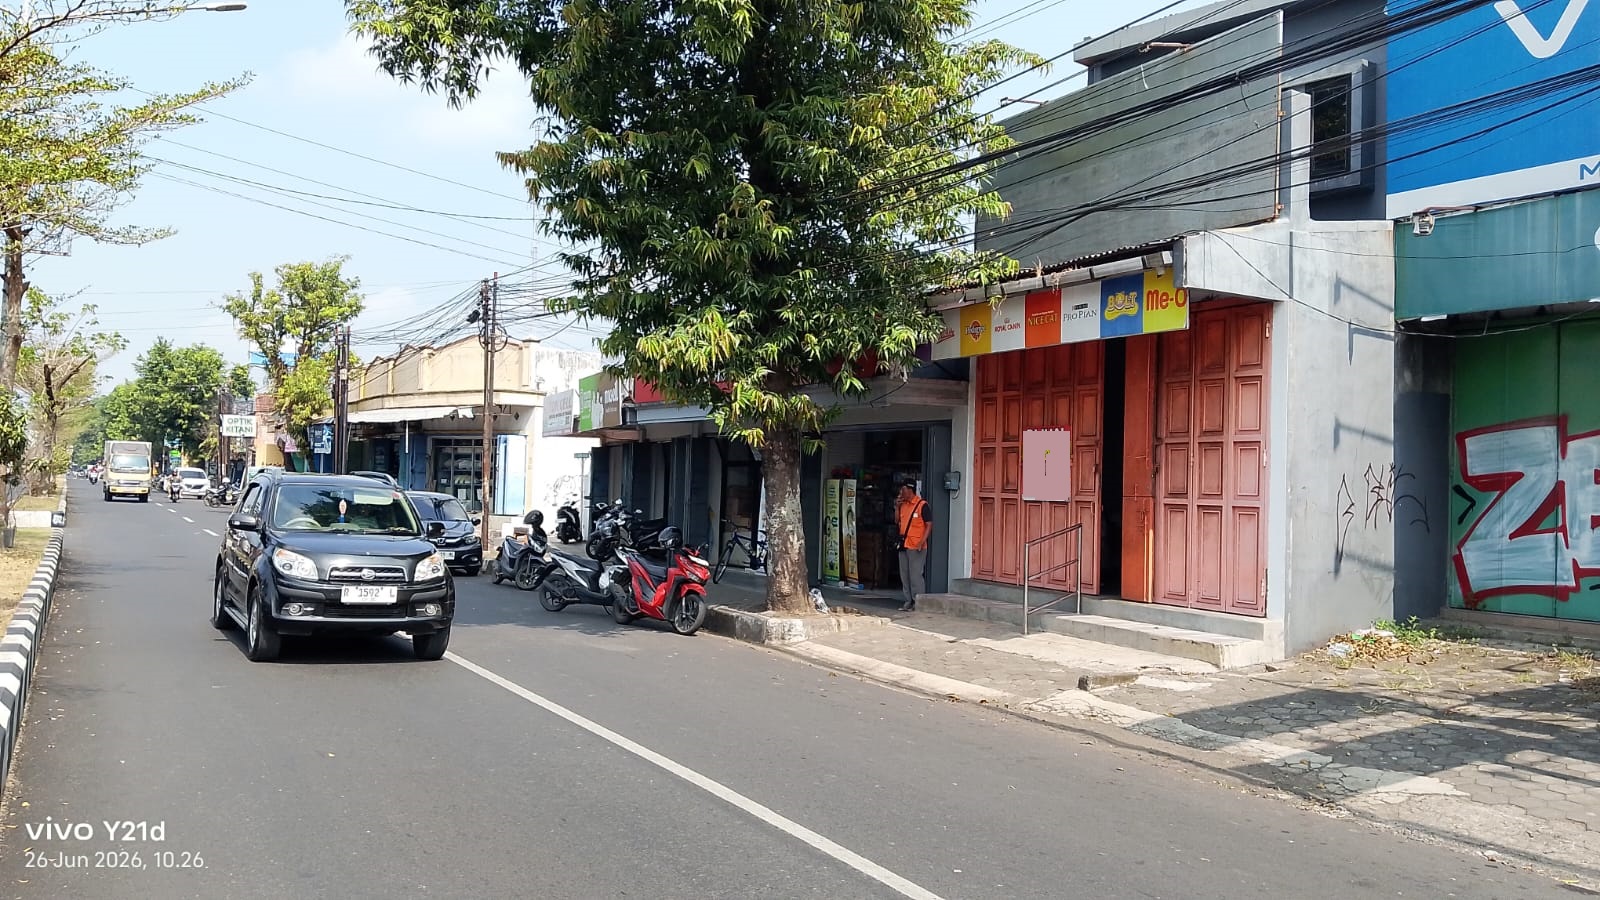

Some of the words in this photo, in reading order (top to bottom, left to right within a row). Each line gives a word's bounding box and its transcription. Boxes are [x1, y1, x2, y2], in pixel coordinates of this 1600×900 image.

[1063, 312, 1078, 322] PRO
[227, 417, 253, 425] OPTIK
[225, 426, 253, 434] KITANI
[390, 588, 395, 598] L
